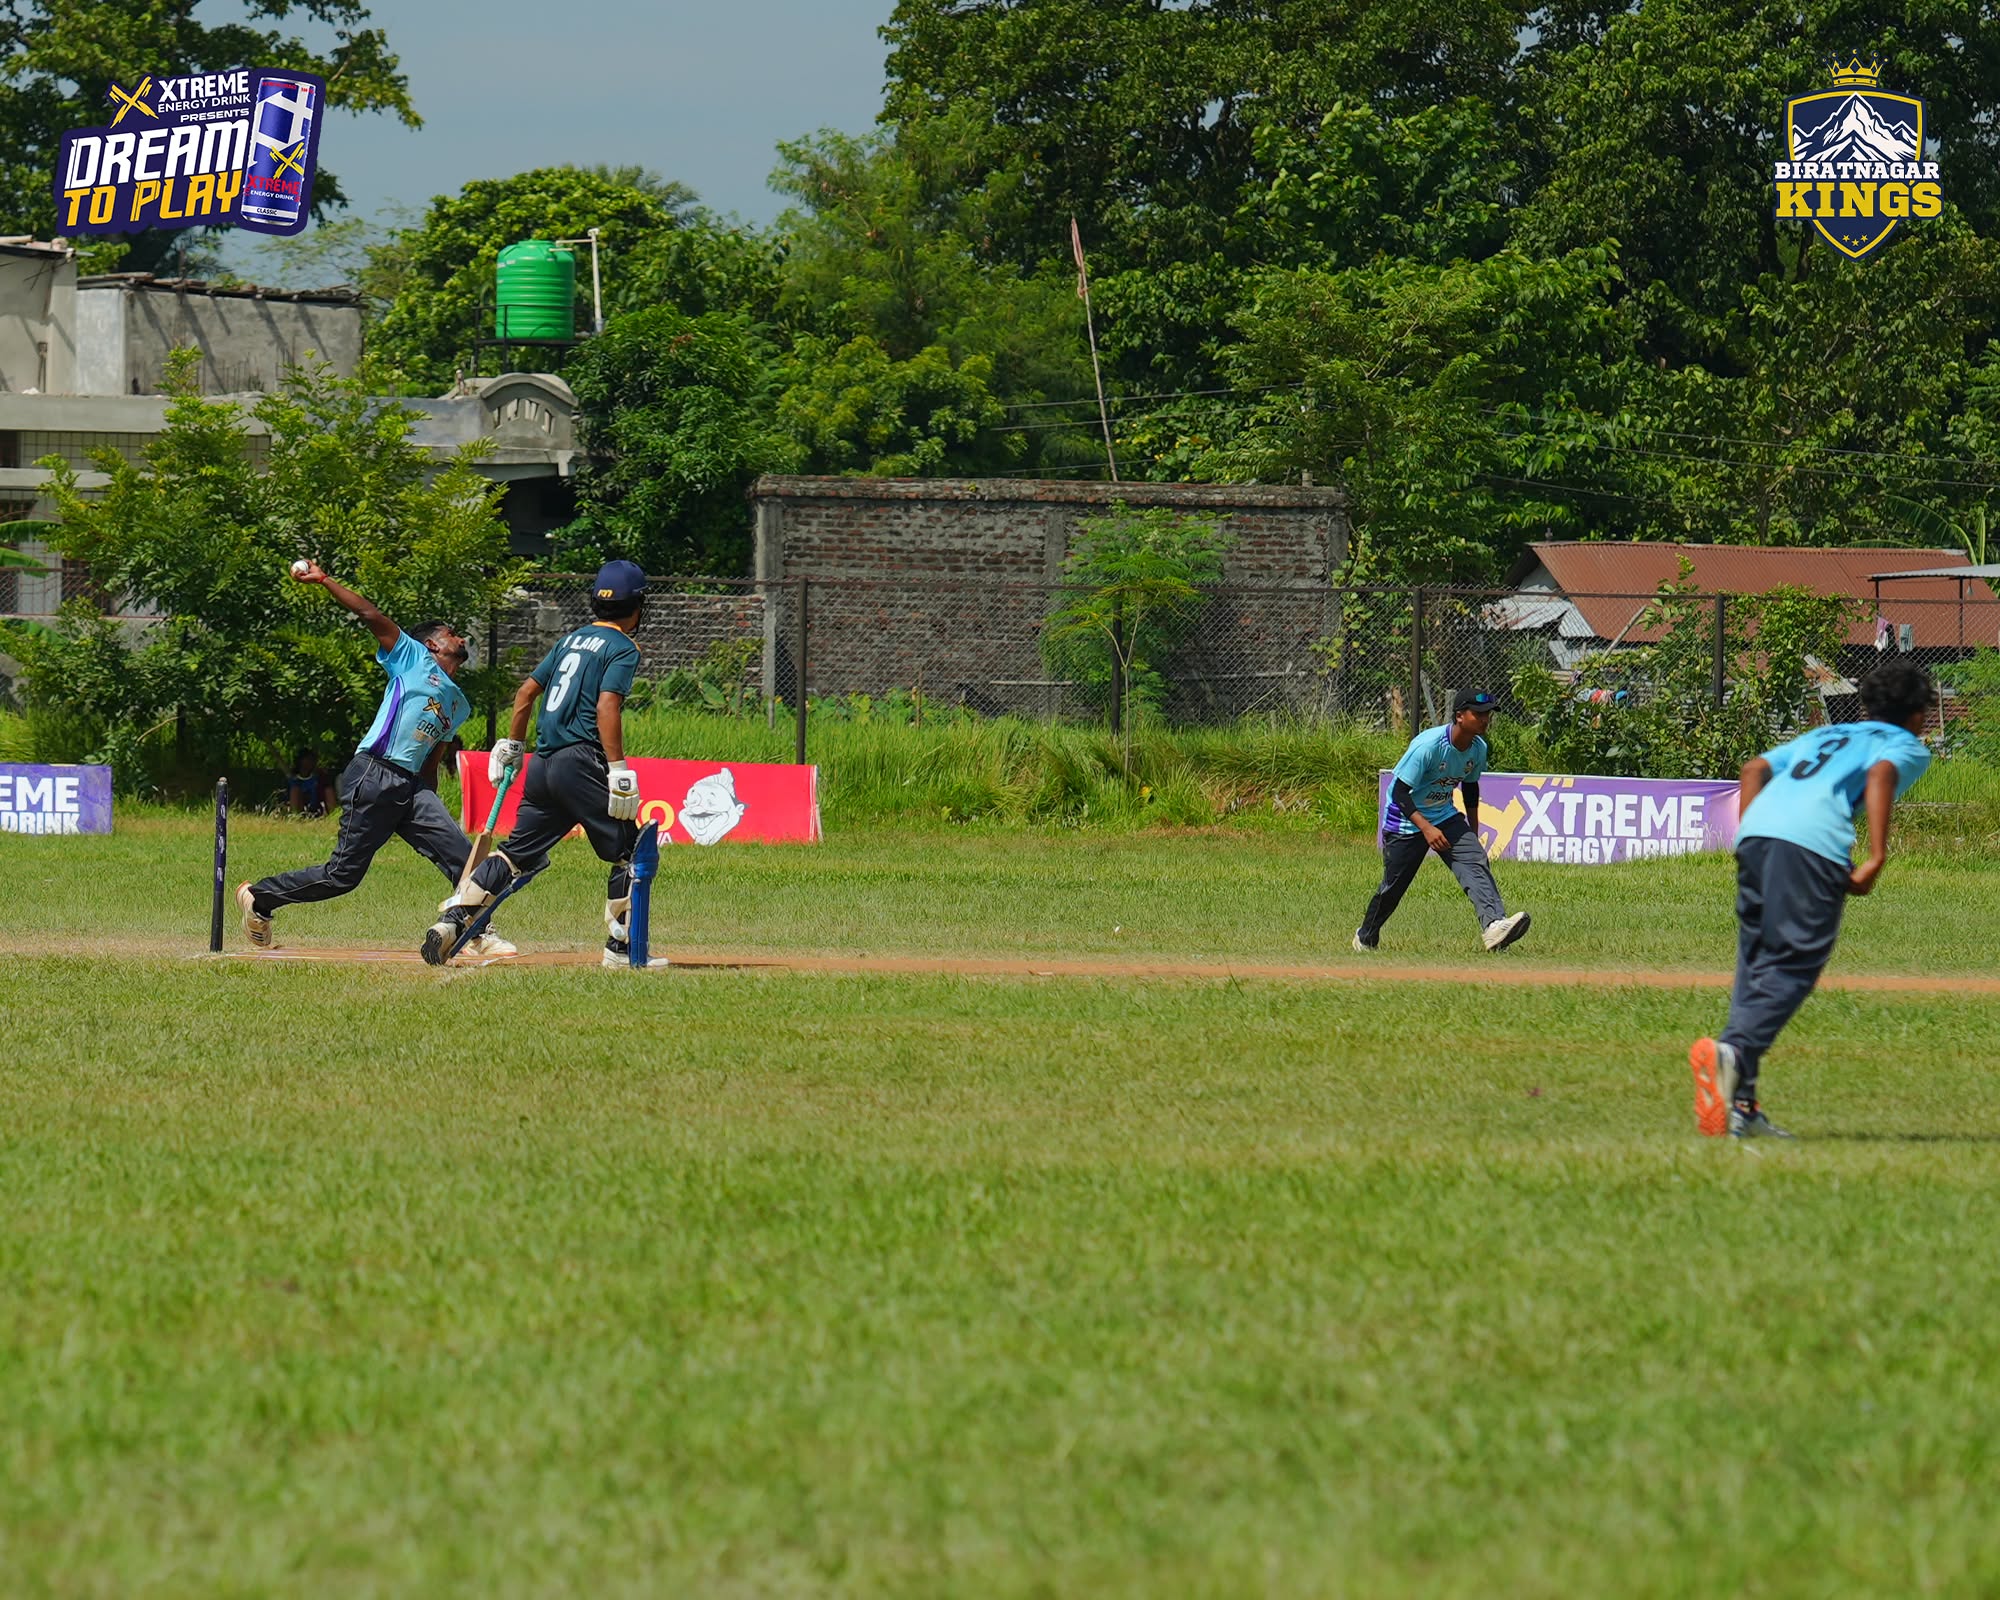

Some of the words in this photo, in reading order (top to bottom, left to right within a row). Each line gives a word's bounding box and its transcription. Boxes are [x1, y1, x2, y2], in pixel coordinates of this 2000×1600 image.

[545, 652, 582, 713] 3
[1790, 736, 1850, 781] 3
[0, 811, 81, 835] DRINK
[1518, 790, 1706, 839] XTREME
[1517, 835, 1618, 865] ENERGY
